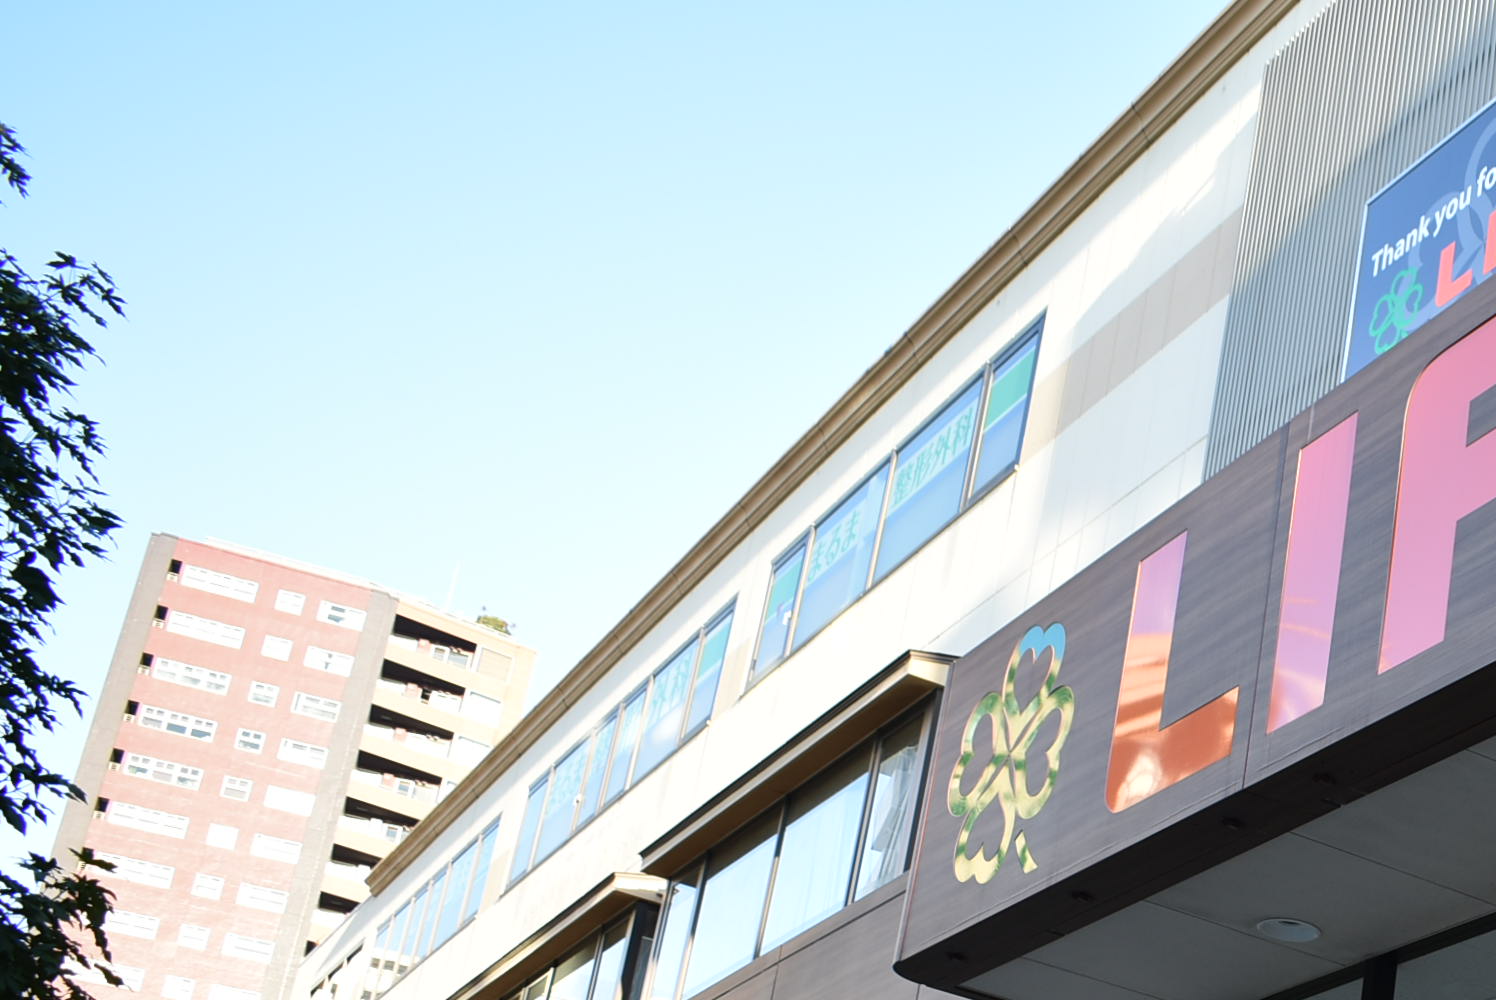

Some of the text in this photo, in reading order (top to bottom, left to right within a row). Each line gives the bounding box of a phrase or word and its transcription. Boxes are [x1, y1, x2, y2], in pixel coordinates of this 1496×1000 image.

[1371, 216, 1430, 279] Thank
[1434, 191, 1473, 234] you
[893, 406, 975, 509] 整形外科
